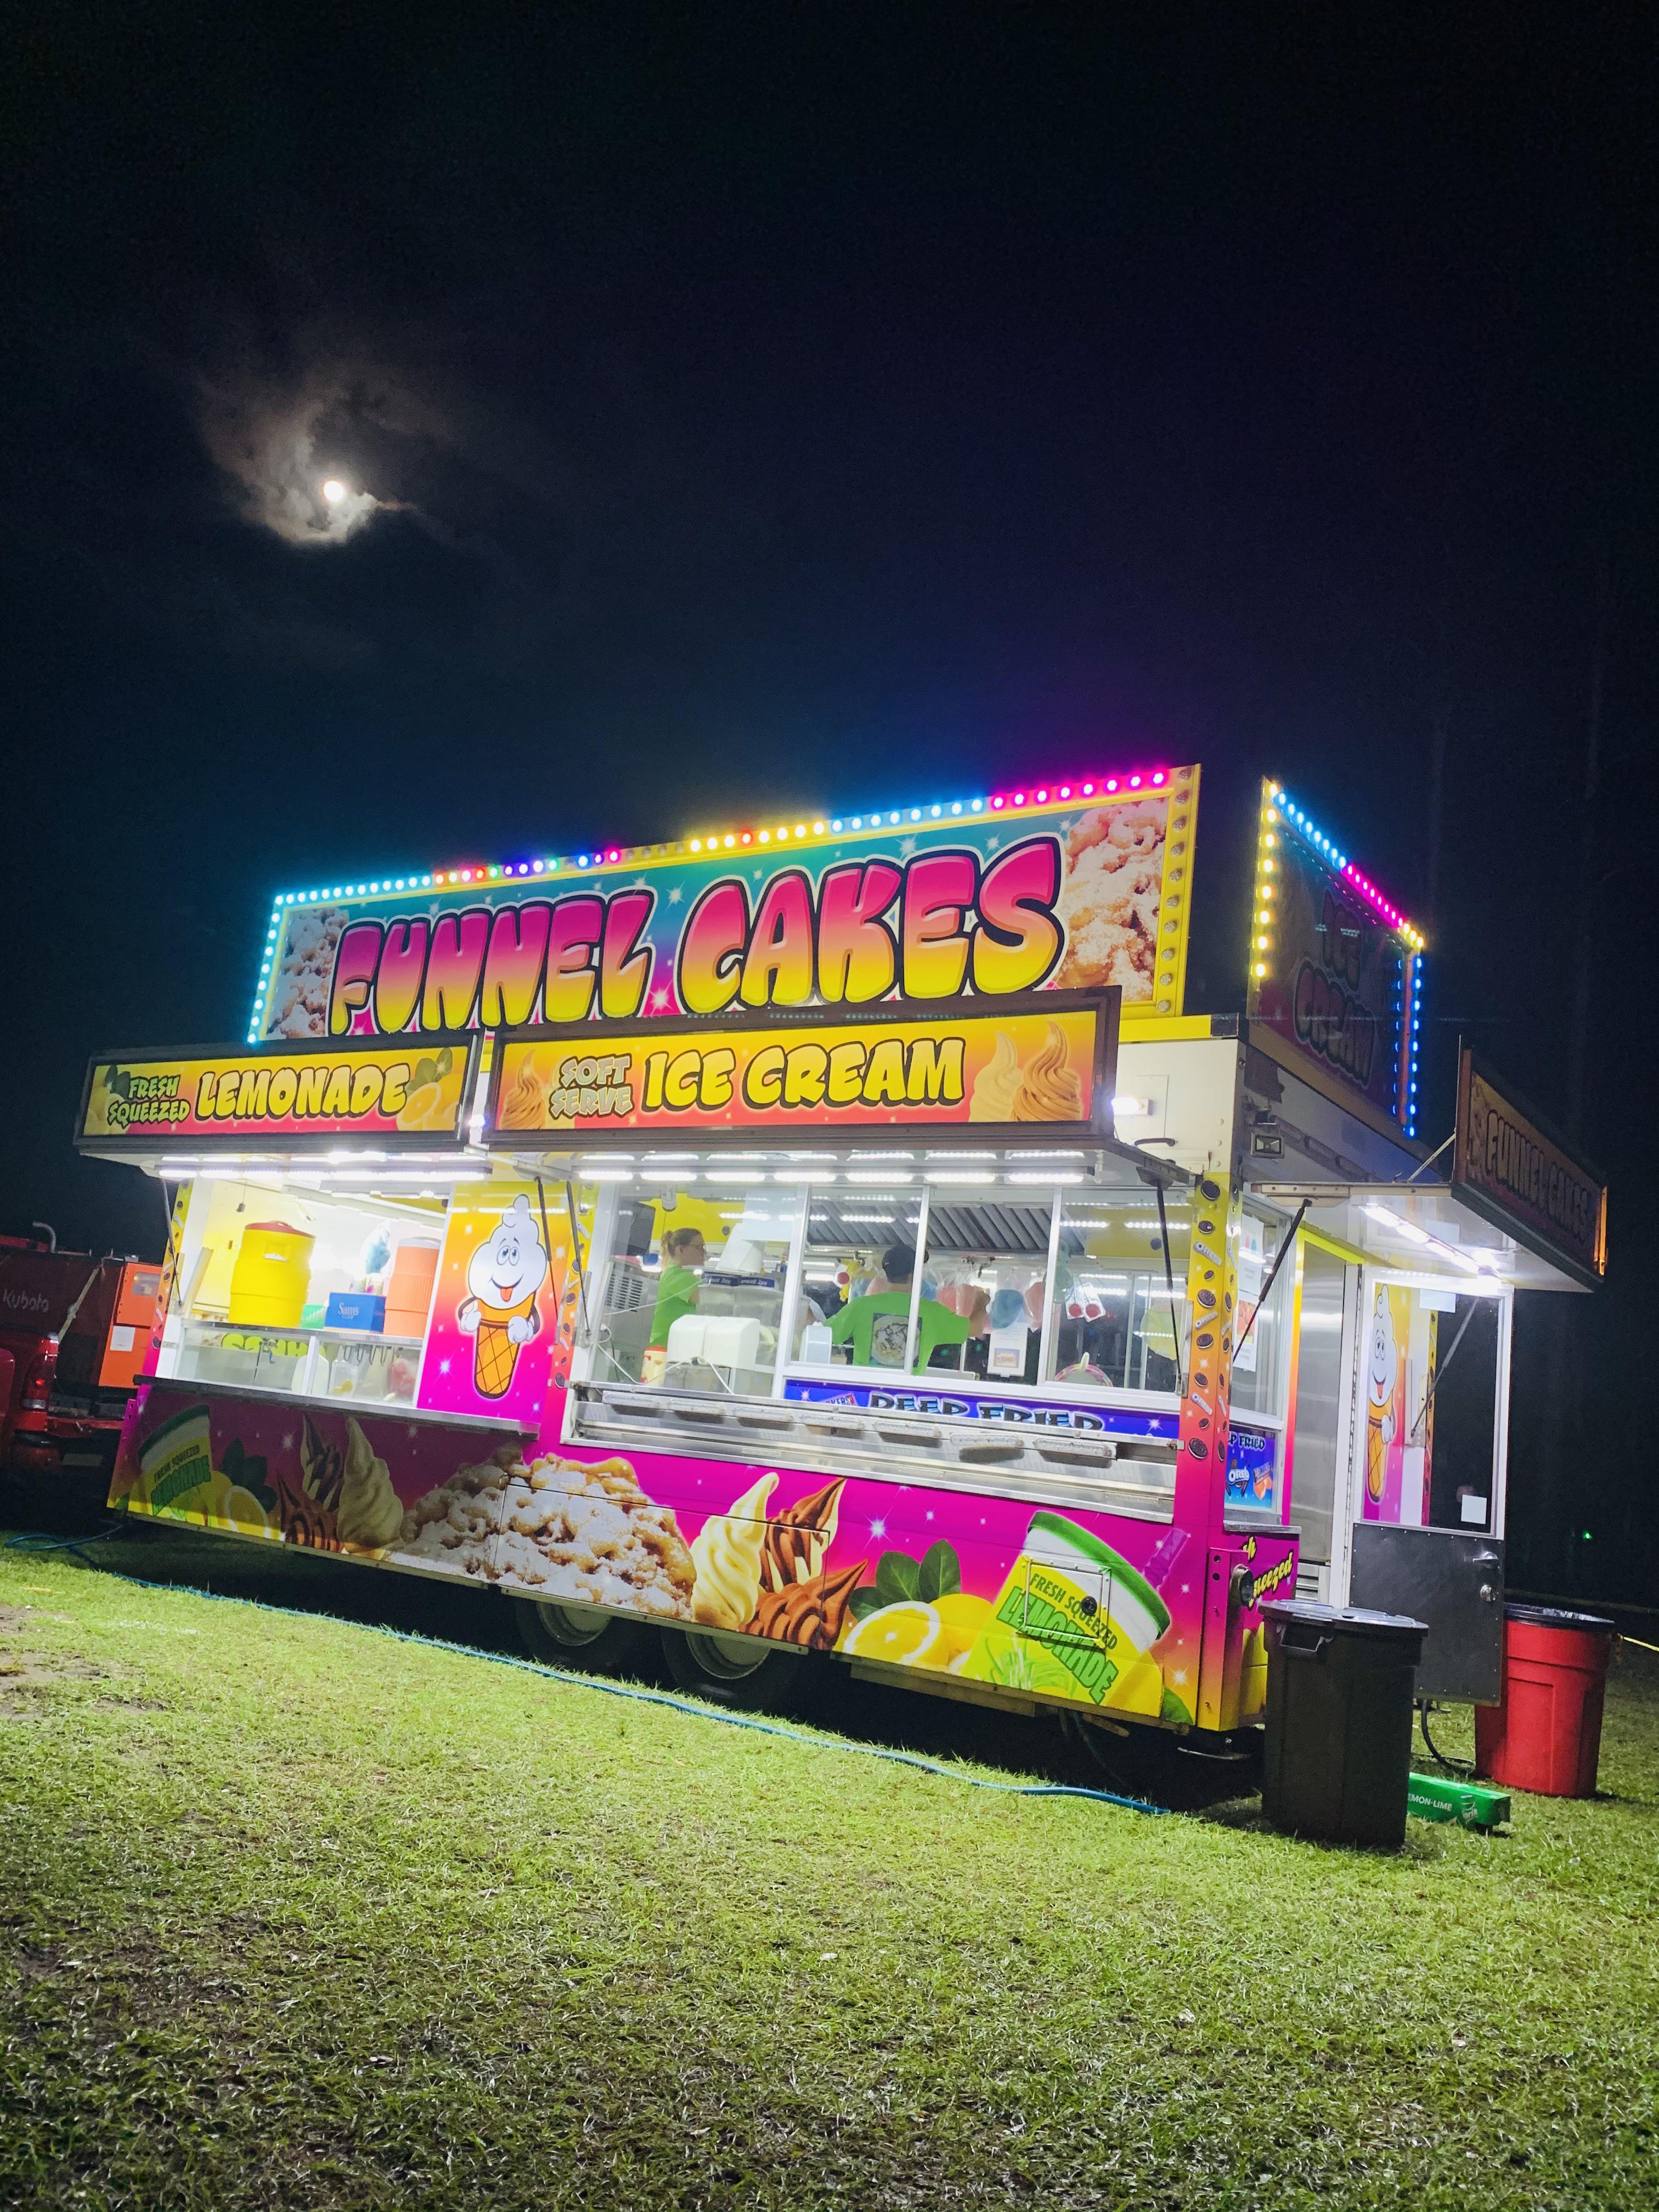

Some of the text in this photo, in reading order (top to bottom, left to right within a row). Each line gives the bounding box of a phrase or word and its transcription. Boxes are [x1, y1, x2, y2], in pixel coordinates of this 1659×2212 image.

[330, 836, 1064, 1035] FUNNEL CAKES
[1322, 889, 1361, 991] ICE
[1295, 958, 1376, 1088] CREAM
[128, 1075, 179, 1100] FRESH
[558, 1053, 633, 1089] SOFT
[642, 1037, 966, 1110] ICE CREAM
[196, 1063, 410, 1120] LEMONADE
[549, 1084, 635, 1120] SERVE
[108, 1098, 191, 1127] SQUEEZED
[1486, 1110, 1590, 1243] FUNNEL CAKES
[4, 1288, 49, 1313] Kubota
[869, 1391, 1104, 1431] DEEP FRIED
[1238, 1432, 1266, 1452] FRIED
[1228, 1468, 1250, 1485] OREO
[1029, 1573, 1066, 1603] FRESH
[1248, 1549, 1294, 1610] ueezed
[996, 1585, 1119, 1705] LEMONADE
[1408, 1793, 1453, 1811] EMON-LIME
